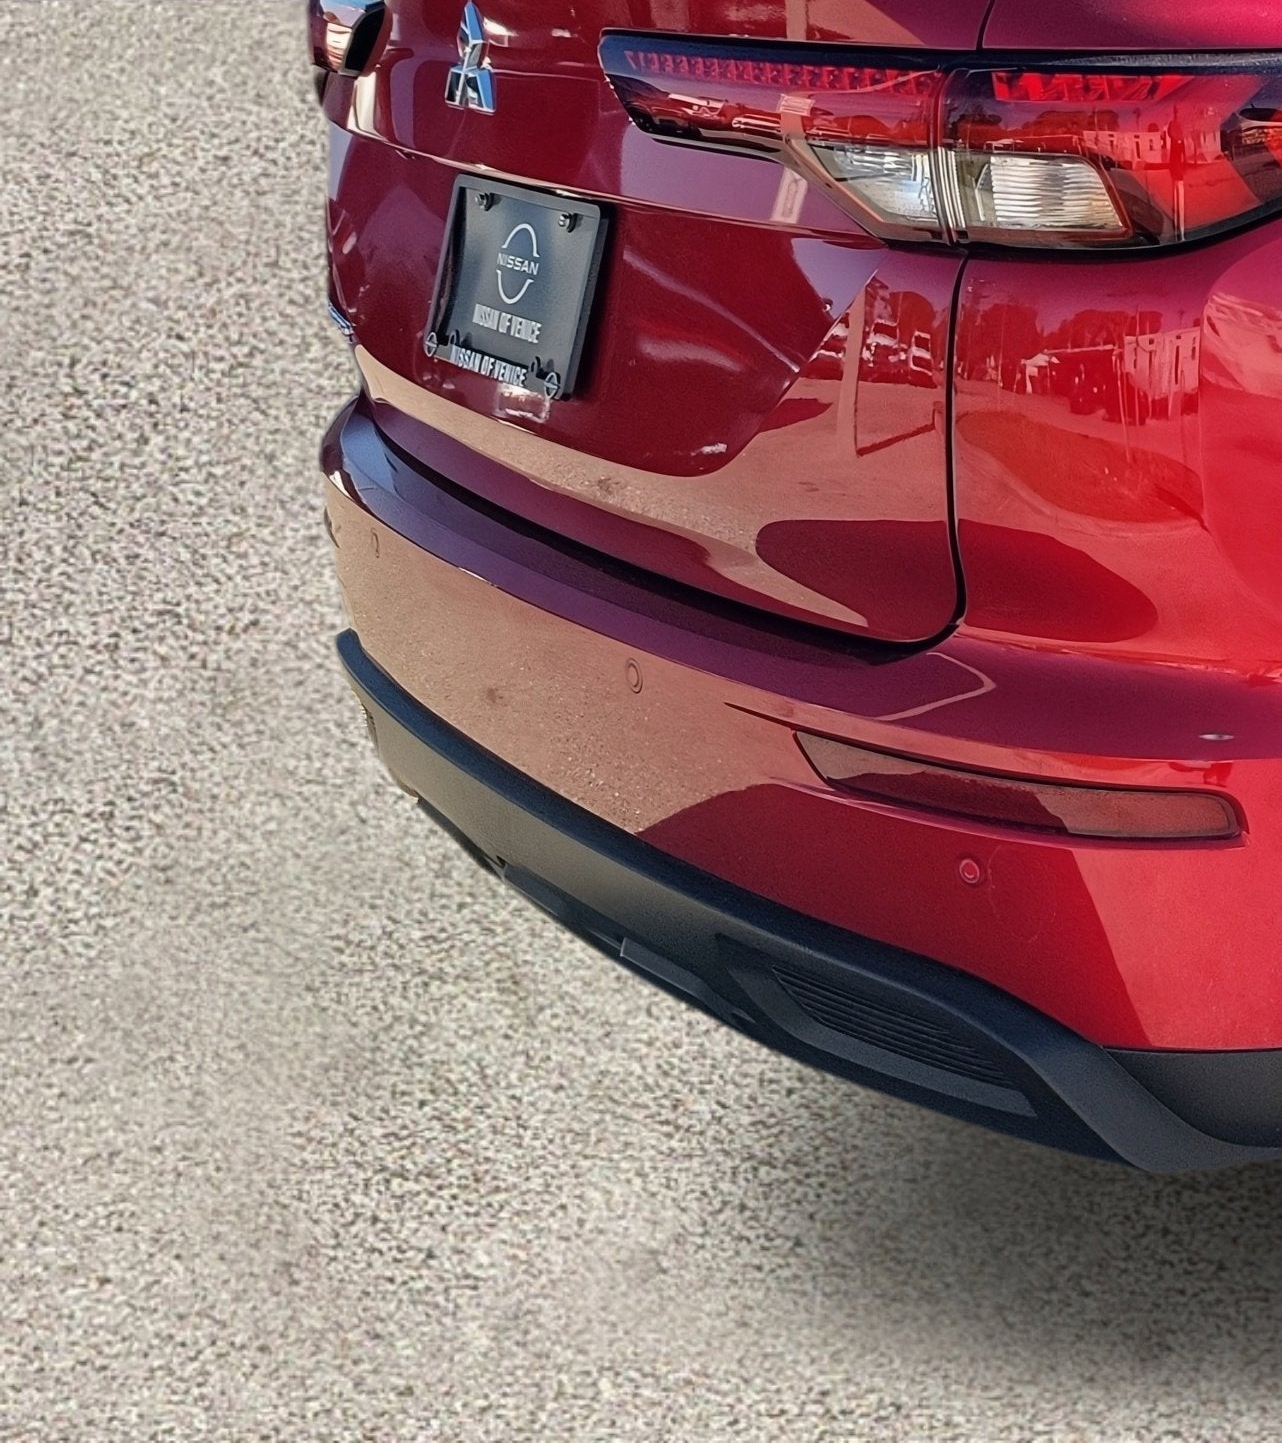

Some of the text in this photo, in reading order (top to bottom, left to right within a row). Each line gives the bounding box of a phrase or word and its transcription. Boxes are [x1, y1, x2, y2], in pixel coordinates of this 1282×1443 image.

[496, 252, 540, 276] NISSAN
[472, 303, 542, 344] NISSAN OF VENICE
[450, 344, 528, 387] NISSAN OF VENICE
